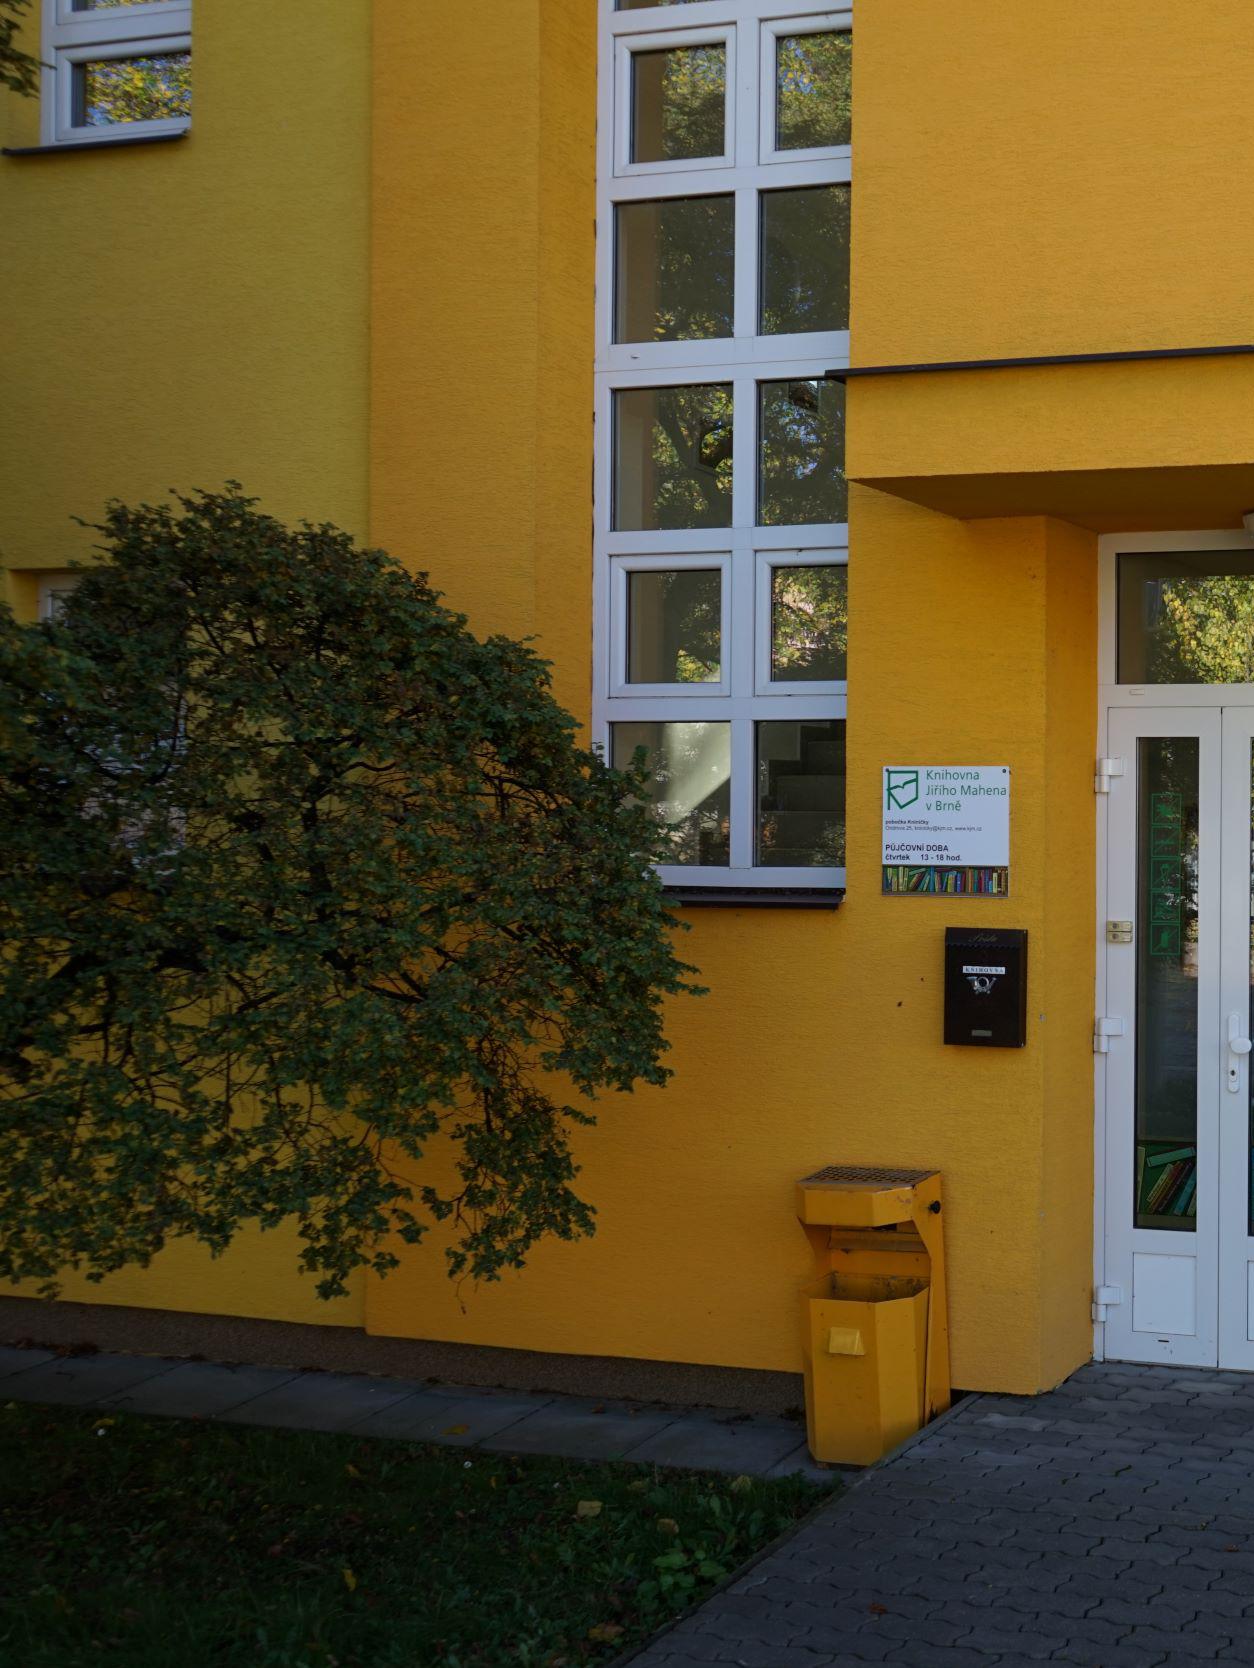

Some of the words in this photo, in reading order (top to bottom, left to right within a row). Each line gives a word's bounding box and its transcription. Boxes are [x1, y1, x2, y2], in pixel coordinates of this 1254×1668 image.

[926, 769, 980, 780] Knihovna
[925, 784, 957, 796] Jiřího
[960, 785, 1007, 796] Mahena
[926, 803, 932, 811] v
[935, 800, 962, 811] Brně
[885, 844, 924, 852] PŮJČOVNÍ
[926, 844, 949, 852] DOBA
[946, 854, 962, 862] hod.
